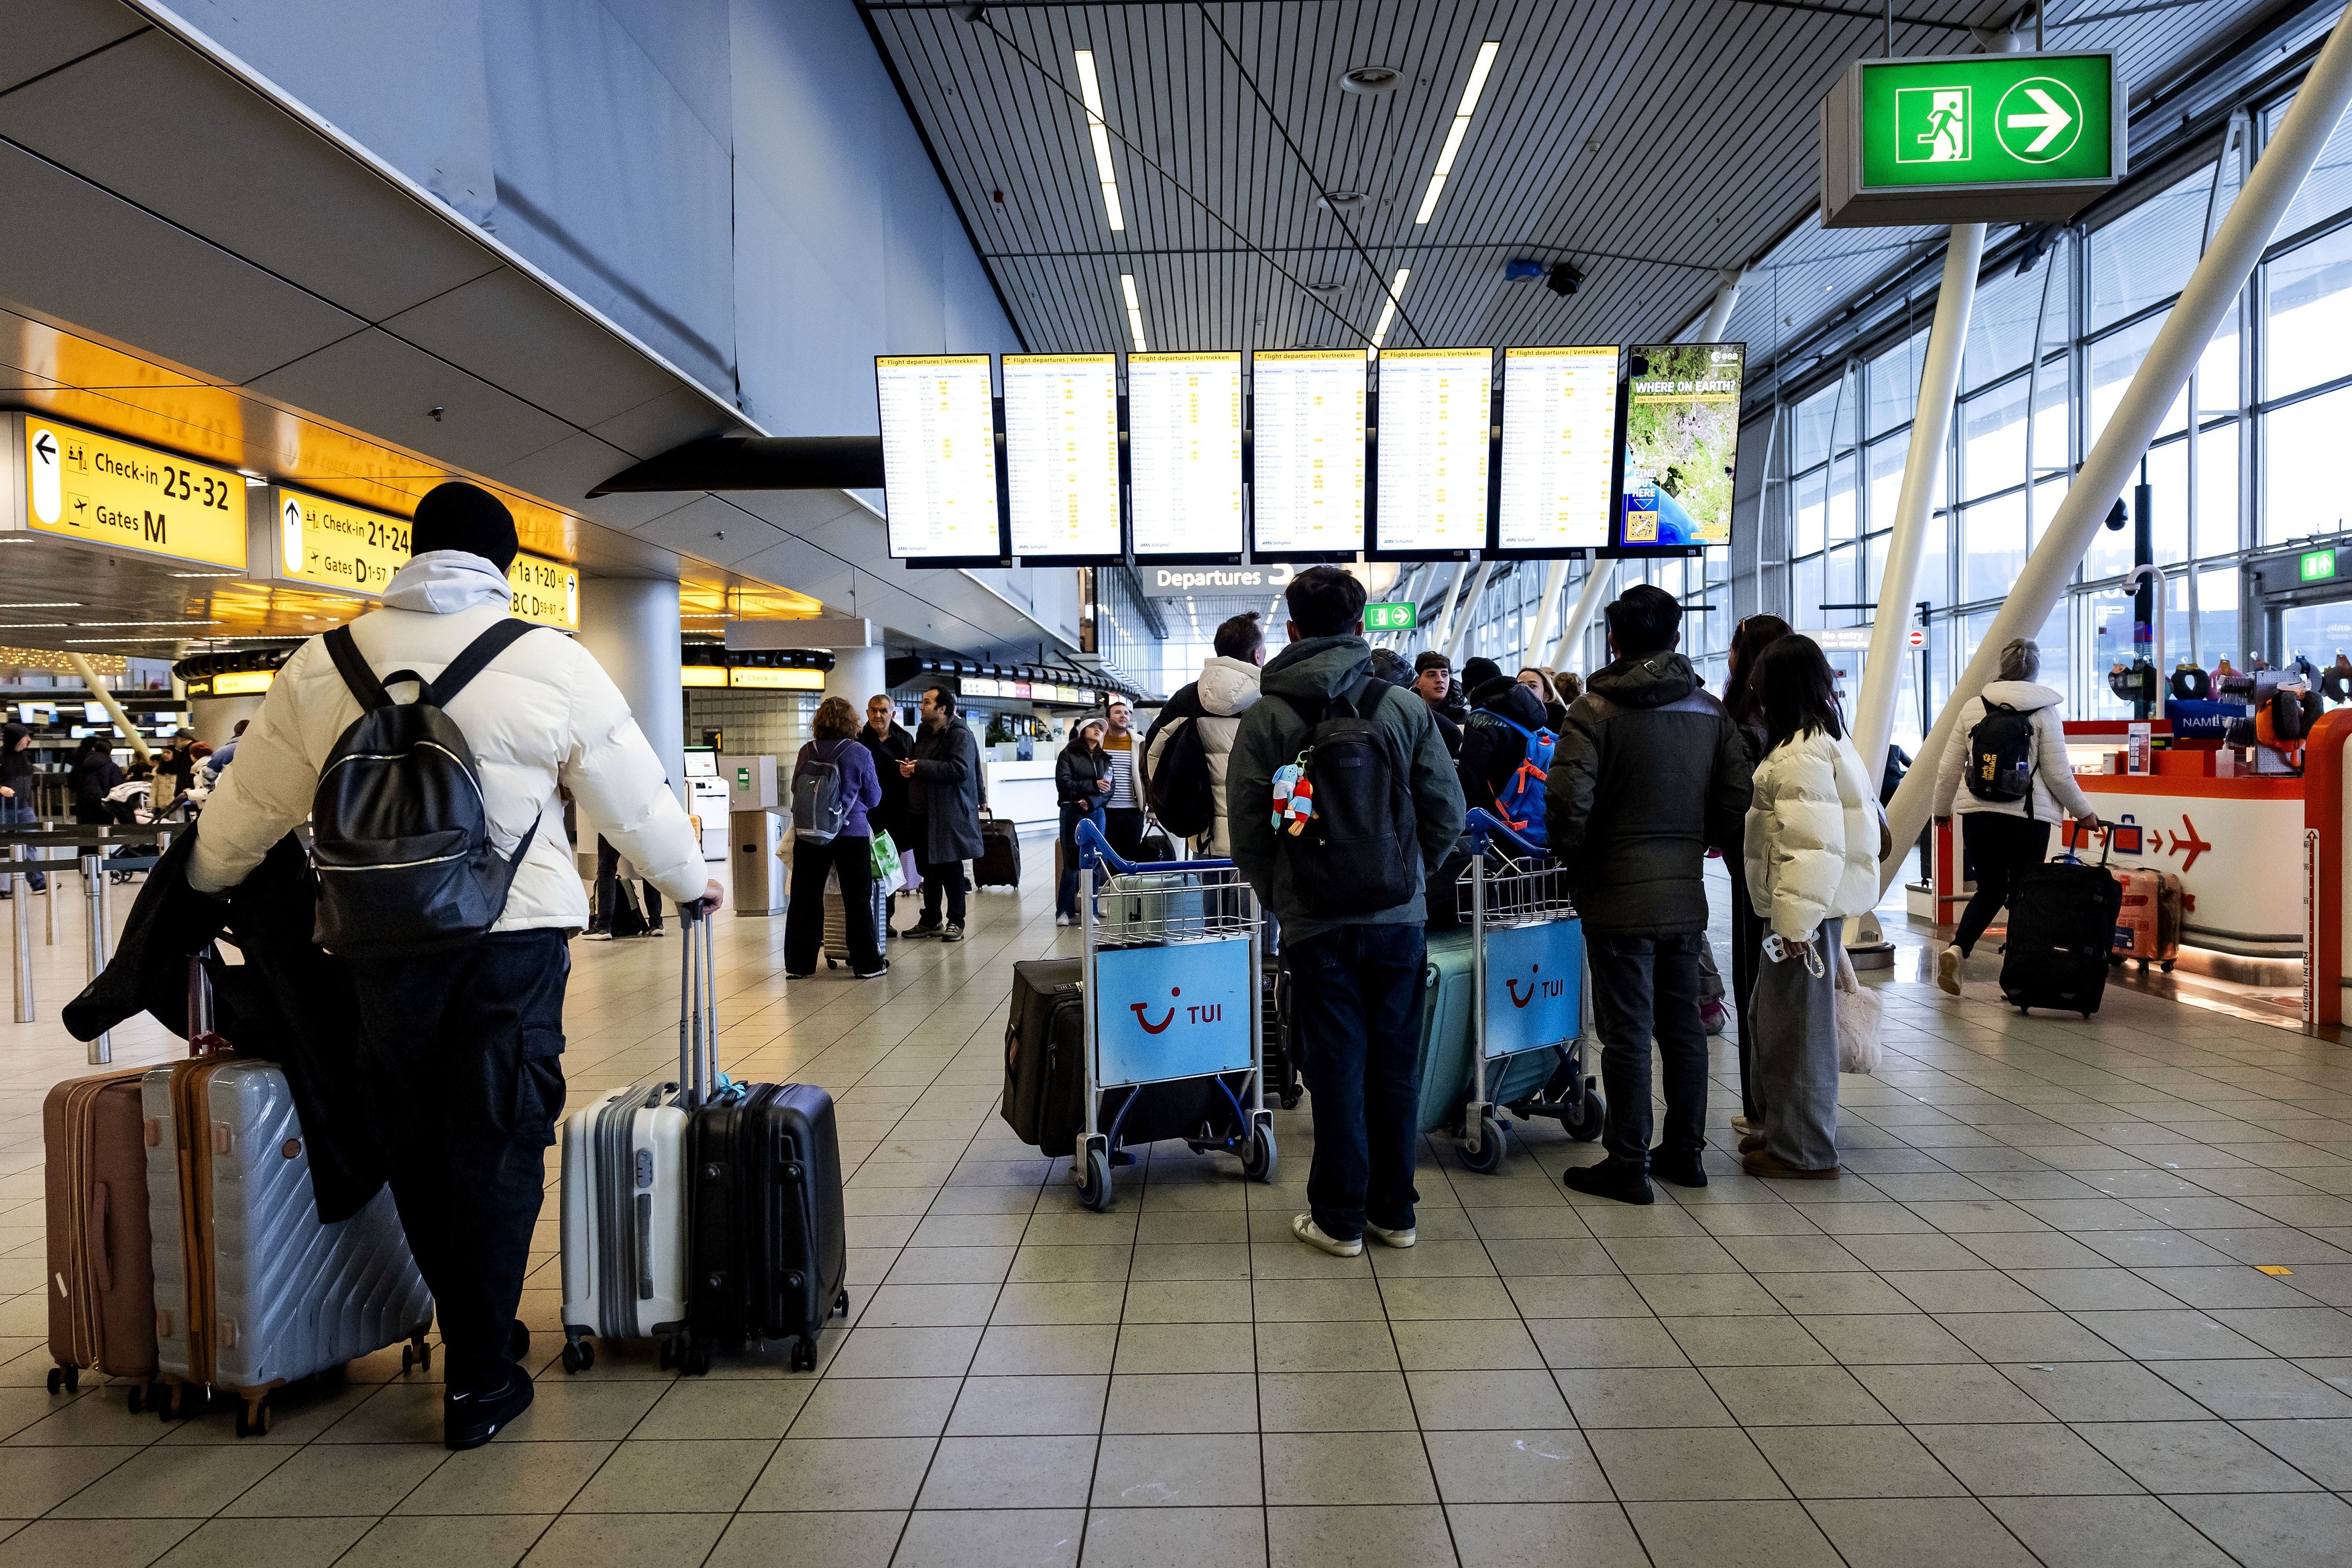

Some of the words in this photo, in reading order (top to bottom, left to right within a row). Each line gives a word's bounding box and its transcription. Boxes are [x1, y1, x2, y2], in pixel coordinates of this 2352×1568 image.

[888, 358, 905, 366] Flight
[1636, 382, 1674, 392] WHERE
[1677, 381, 1692, 392] ON
[1695, 380, 1736, 392] EARTH?
[96, 453, 158, 485] Check-in
[164, 466, 228, 510] 25-32
[1634, 469, 1657, 478] FIND
[1634, 478, 1654, 487] OUT
[1632, 488, 1655, 497] HERE
[97, 506, 138, 530] Gates
[144, 510, 166, 544] M
[323, 514, 364, 537] Check-in
[368, 521, 408, 553] 21-24
[325, 557, 352, 575] Gates
[519, 561, 530, 582] 1a
[535, 565, 555, 588] 1-20
[1157, 570, 1261, 590] Departures
[1822, 631, 1836, 640] No
[1838, 632, 1863, 641] entry
[715, 733, 721, 749] 1
[2304, 951, 2309, 966] CM
[2304, 968, 2309, 977] IN
[1542, 979, 1563, 998] TUI
[1187, 1004, 1221, 1024] TUI
